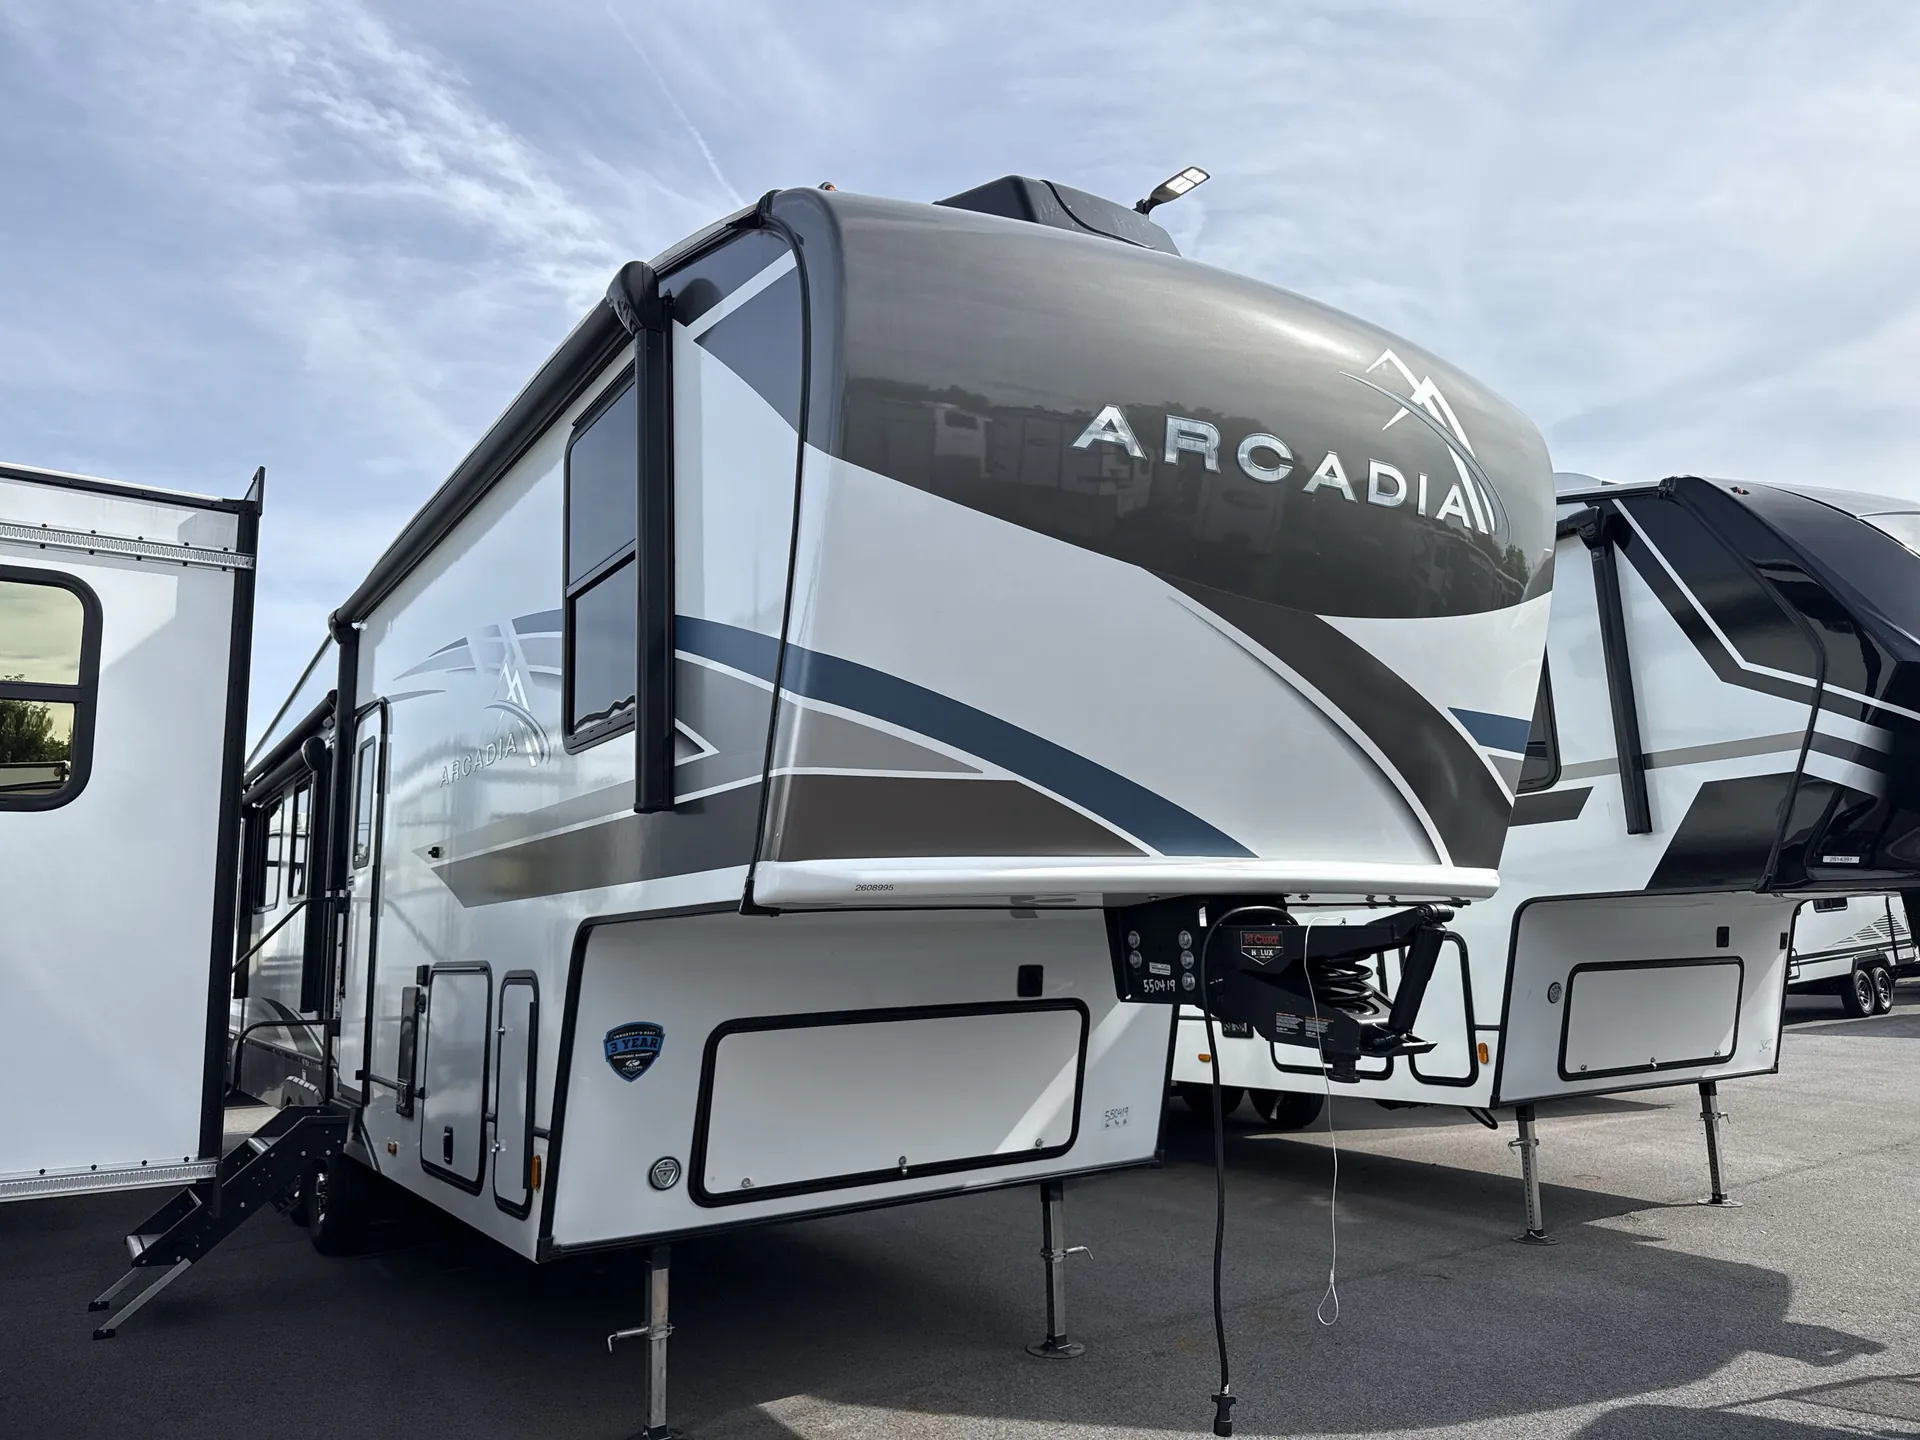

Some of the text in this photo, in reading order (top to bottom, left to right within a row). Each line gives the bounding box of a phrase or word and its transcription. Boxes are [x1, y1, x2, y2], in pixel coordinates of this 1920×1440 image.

[1069, 403, 1473, 531] ARCADIA
[439, 732, 518, 788] ARCADIA
[854, 883, 895, 892] 2608995
[1143, 979, 1176, 994] 550419
[610, 1037, 658, 1053] 3 YEAR
